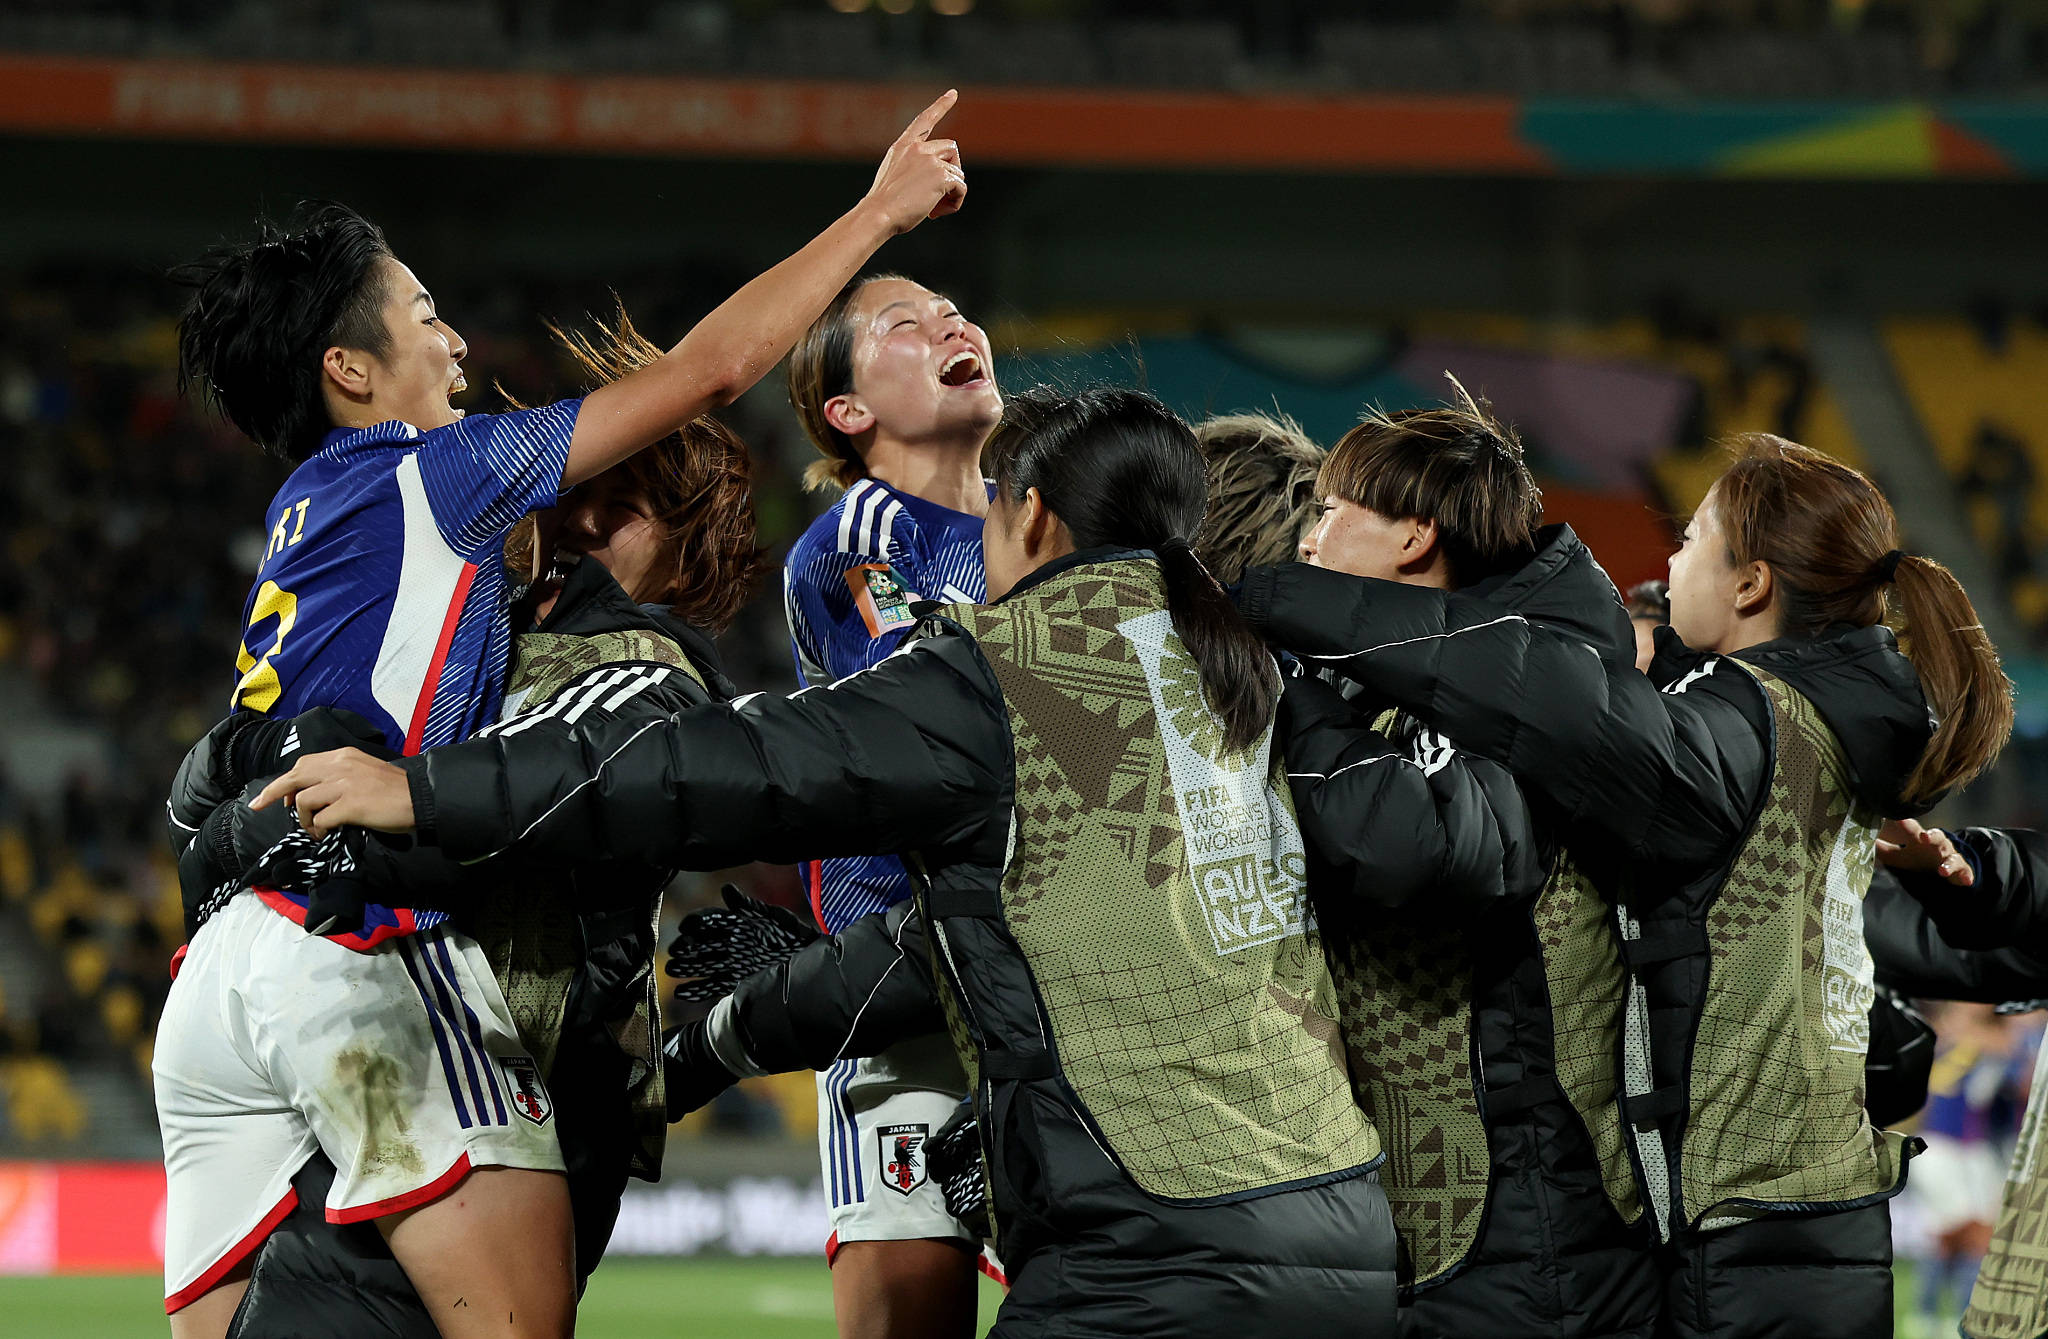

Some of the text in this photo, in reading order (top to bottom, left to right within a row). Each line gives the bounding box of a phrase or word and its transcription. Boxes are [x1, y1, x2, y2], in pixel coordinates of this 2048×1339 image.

[1184, 784, 1232, 813] FIFA
[1193, 826, 1256, 853] WORLD
[1203, 863, 1256, 906] AU
[1213, 901, 1278, 942] NZ
[888, 1125, 917, 1134] JAPAN
